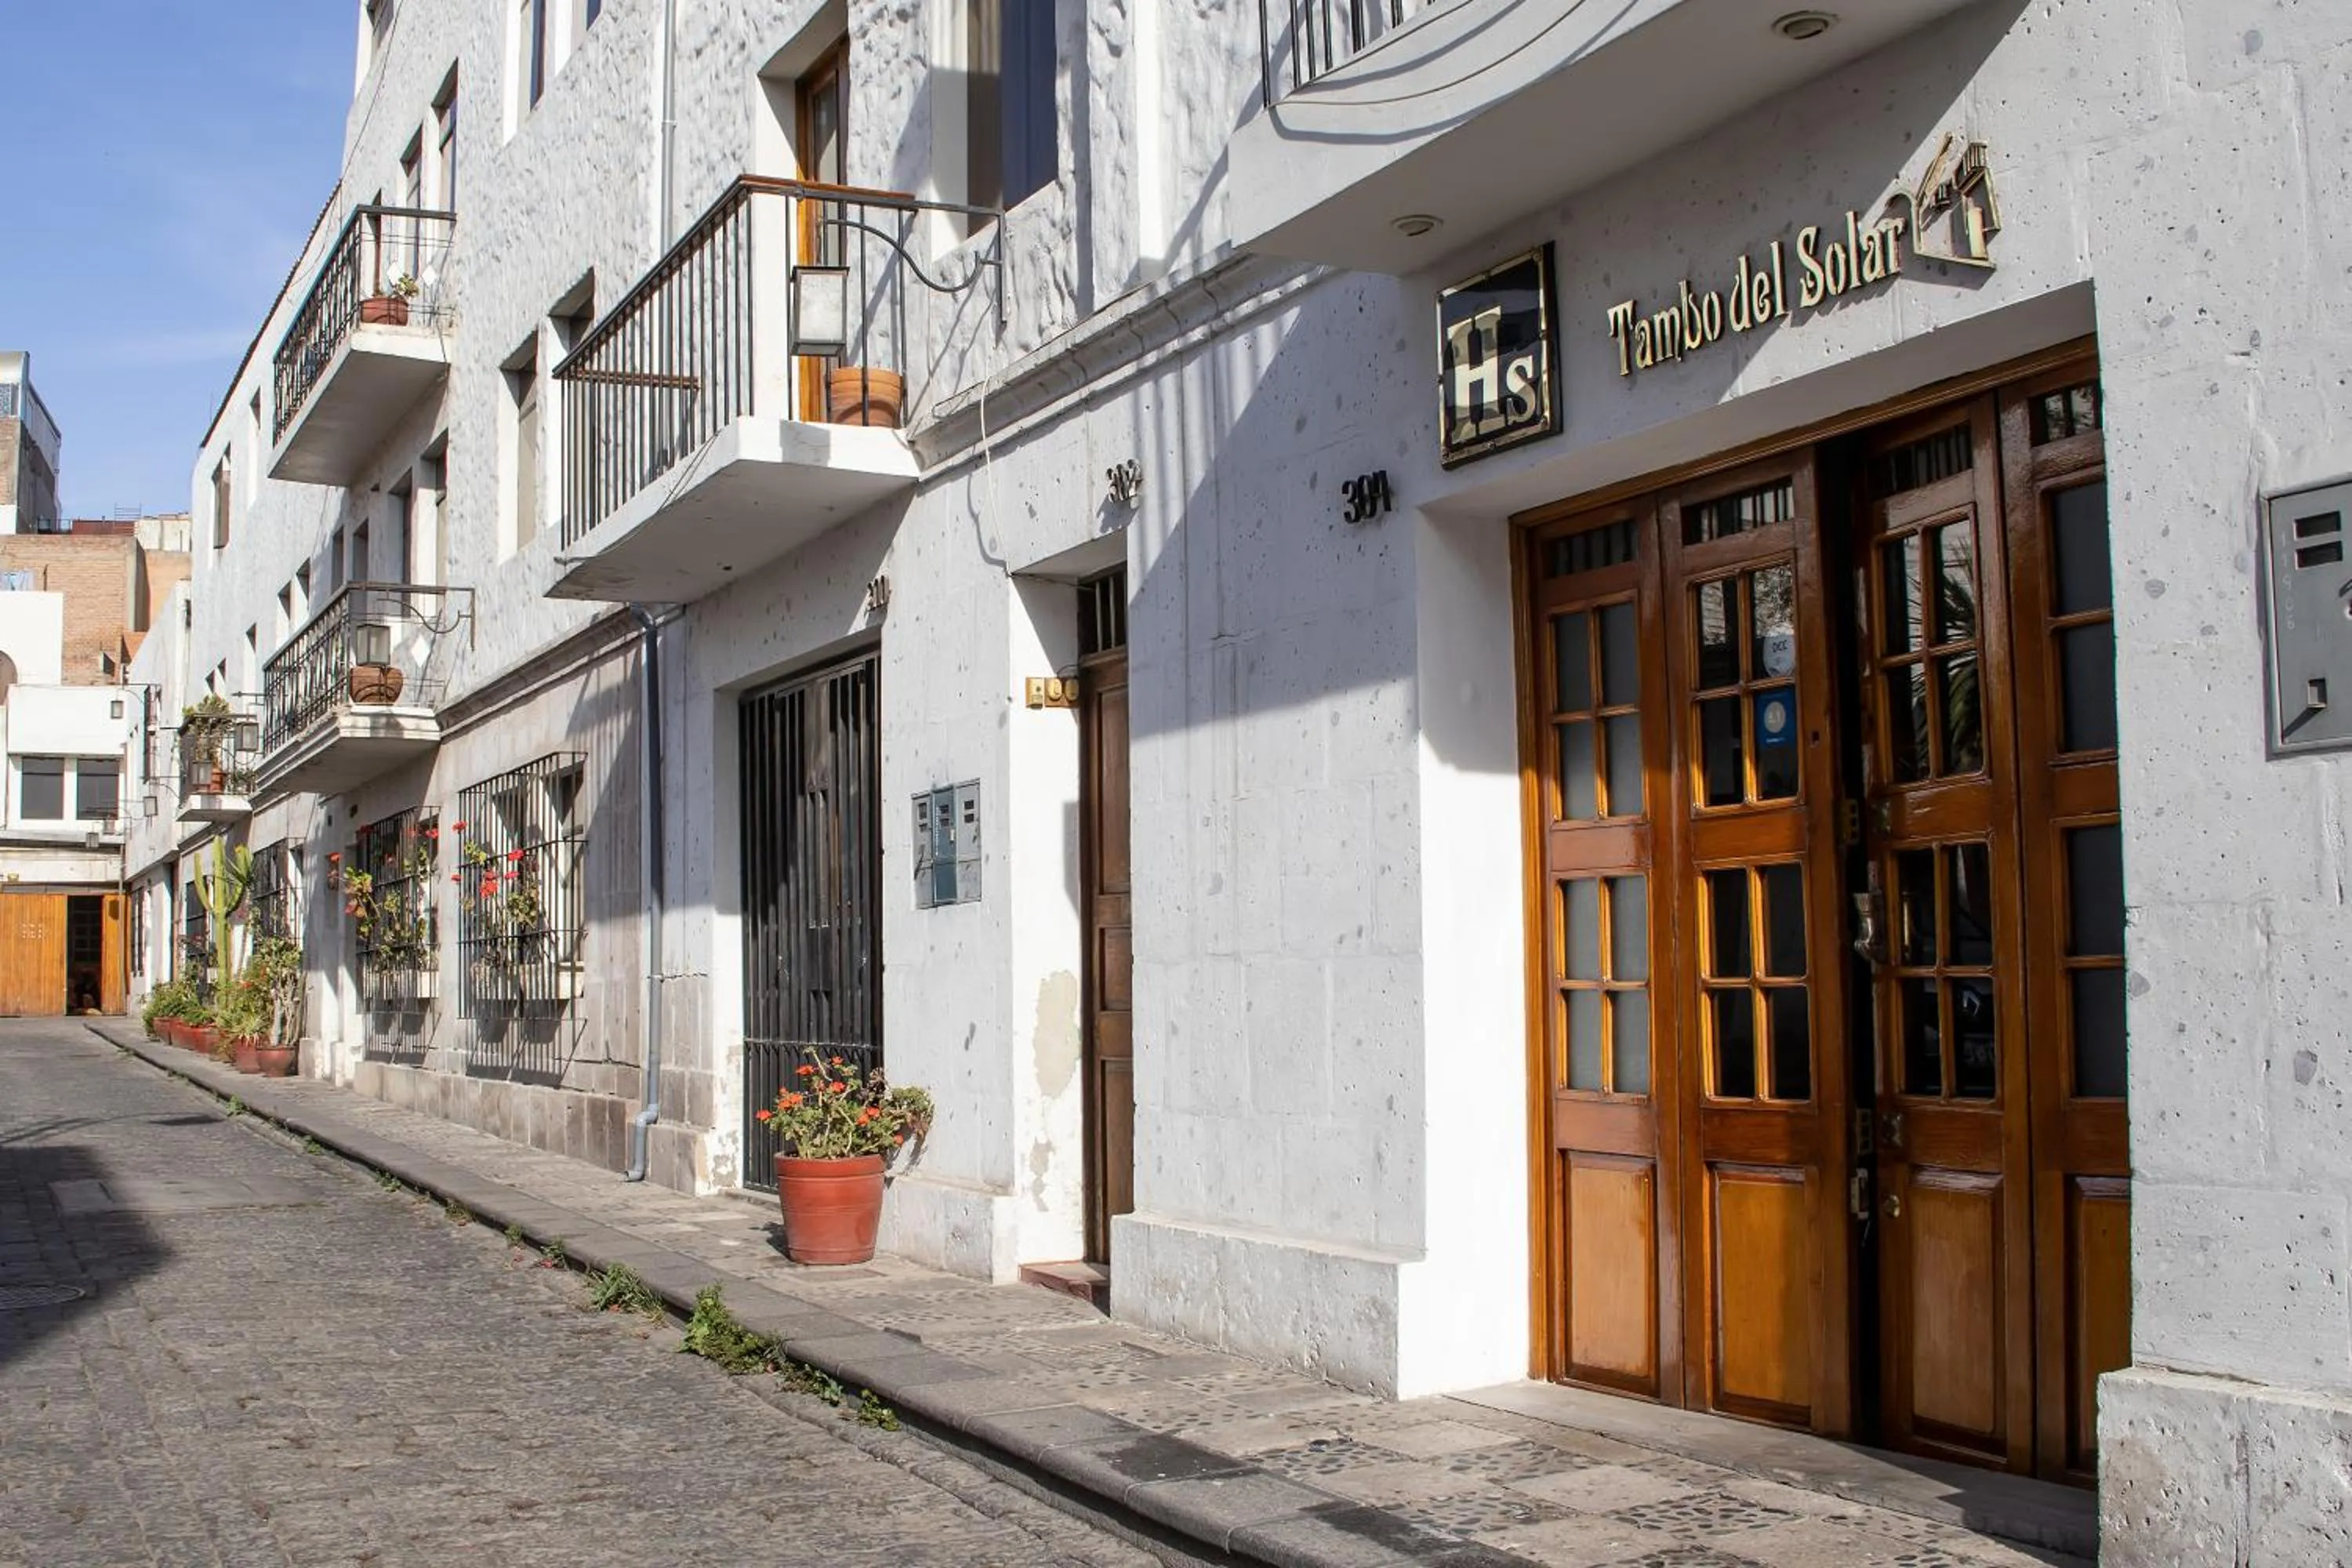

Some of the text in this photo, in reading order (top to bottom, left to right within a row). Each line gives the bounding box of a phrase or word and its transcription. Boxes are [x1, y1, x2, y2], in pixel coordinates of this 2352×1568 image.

[1607, 210, 1907, 377] Tambo del Solar
[1341, 470, 1392, 523] 304
